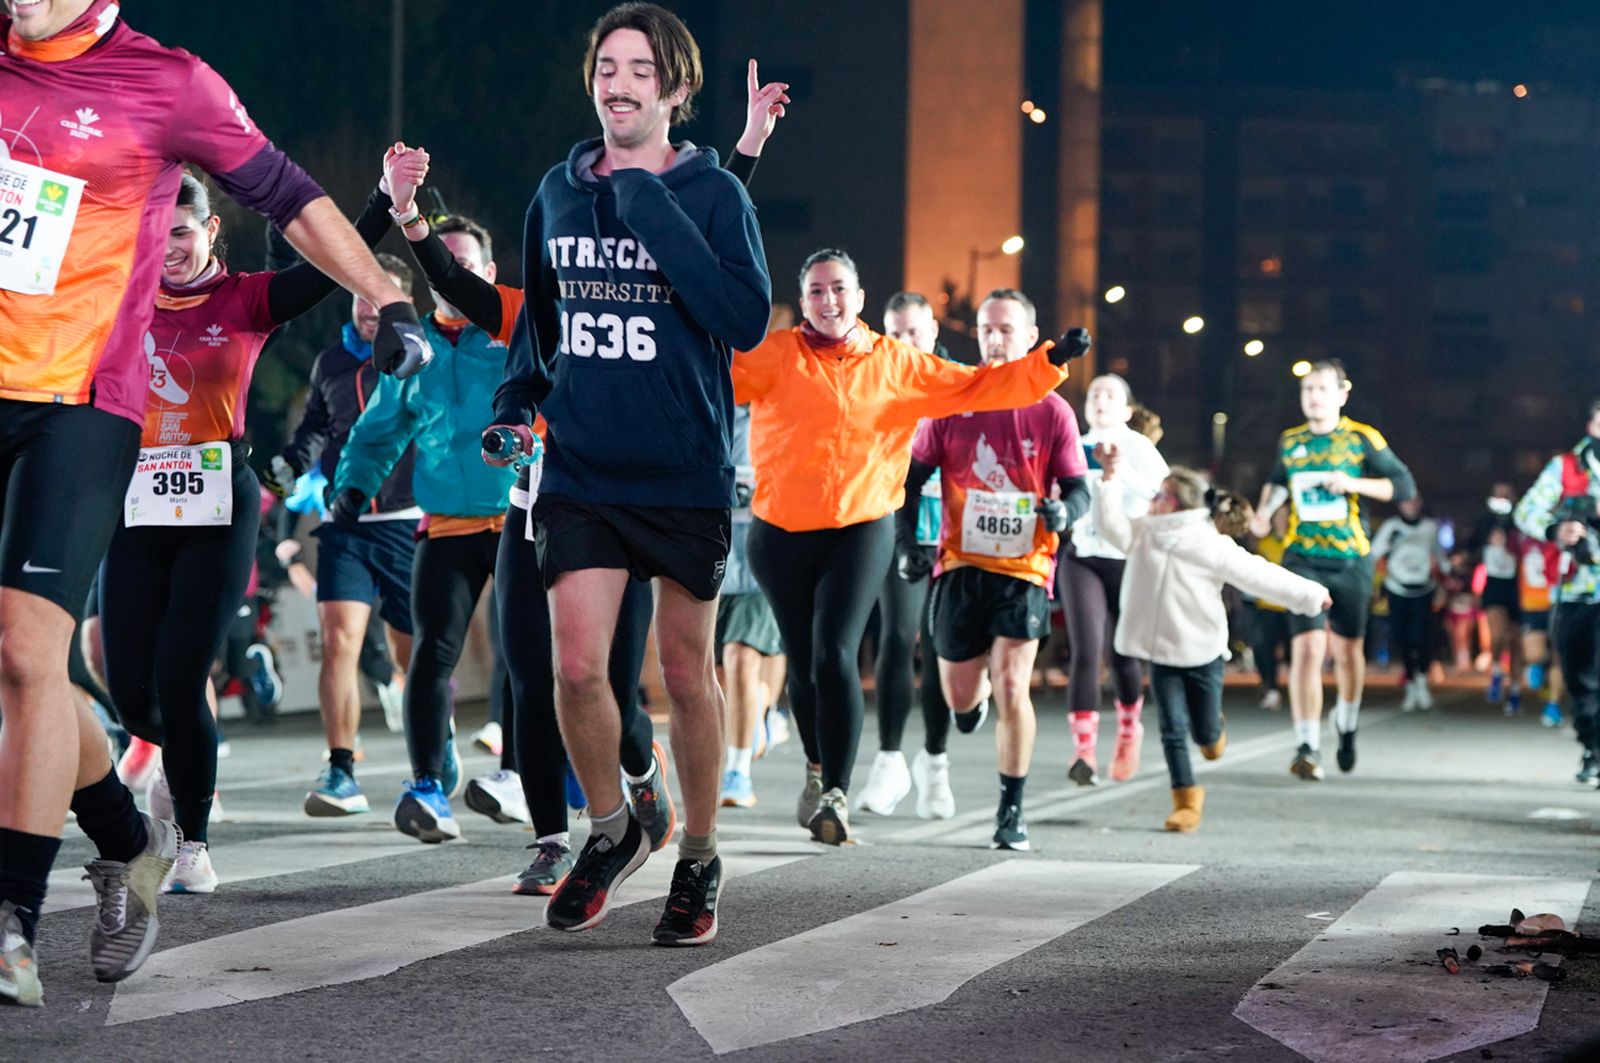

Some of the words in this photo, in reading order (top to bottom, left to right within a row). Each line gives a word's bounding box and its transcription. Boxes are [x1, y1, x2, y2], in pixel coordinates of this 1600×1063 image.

[12, 176, 28, 190] DE
[0, 208, 38, 250] 21
[560, 310, 657, 361] 1636
[149, 450, 179, 461] NOCHE
[180, 450, 192, 460] DE
[138, 462, 157, 473] SAN
[153, 471, 204, 495] 395
[976, 515, 1022, 536] 4863
